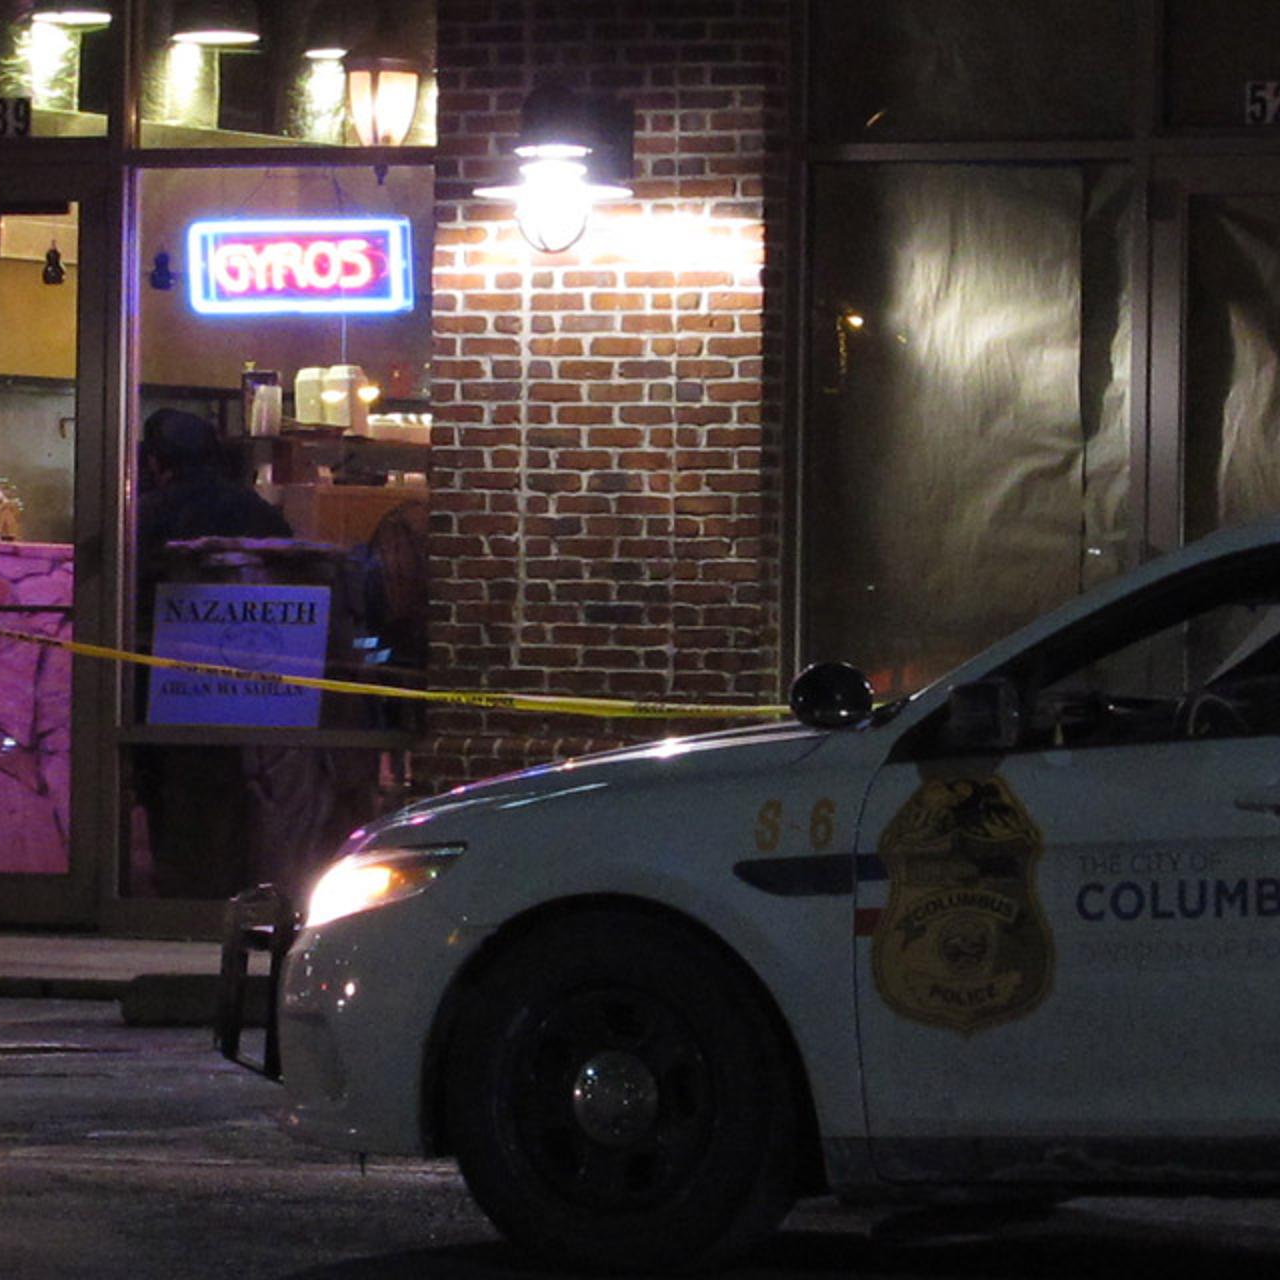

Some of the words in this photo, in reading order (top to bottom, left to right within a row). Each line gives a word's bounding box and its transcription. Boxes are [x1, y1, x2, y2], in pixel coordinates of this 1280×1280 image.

[215, 238, 372, 292] GYROS
[165, 599, 317, 625] NAZARETH
[1079, 854, 1121, 875] THE
[1130, 852, 1182, 874] CITY
[912, 891, 1015, 921] COLUMBUS
[929, 982, 998, 1006] POLICE
